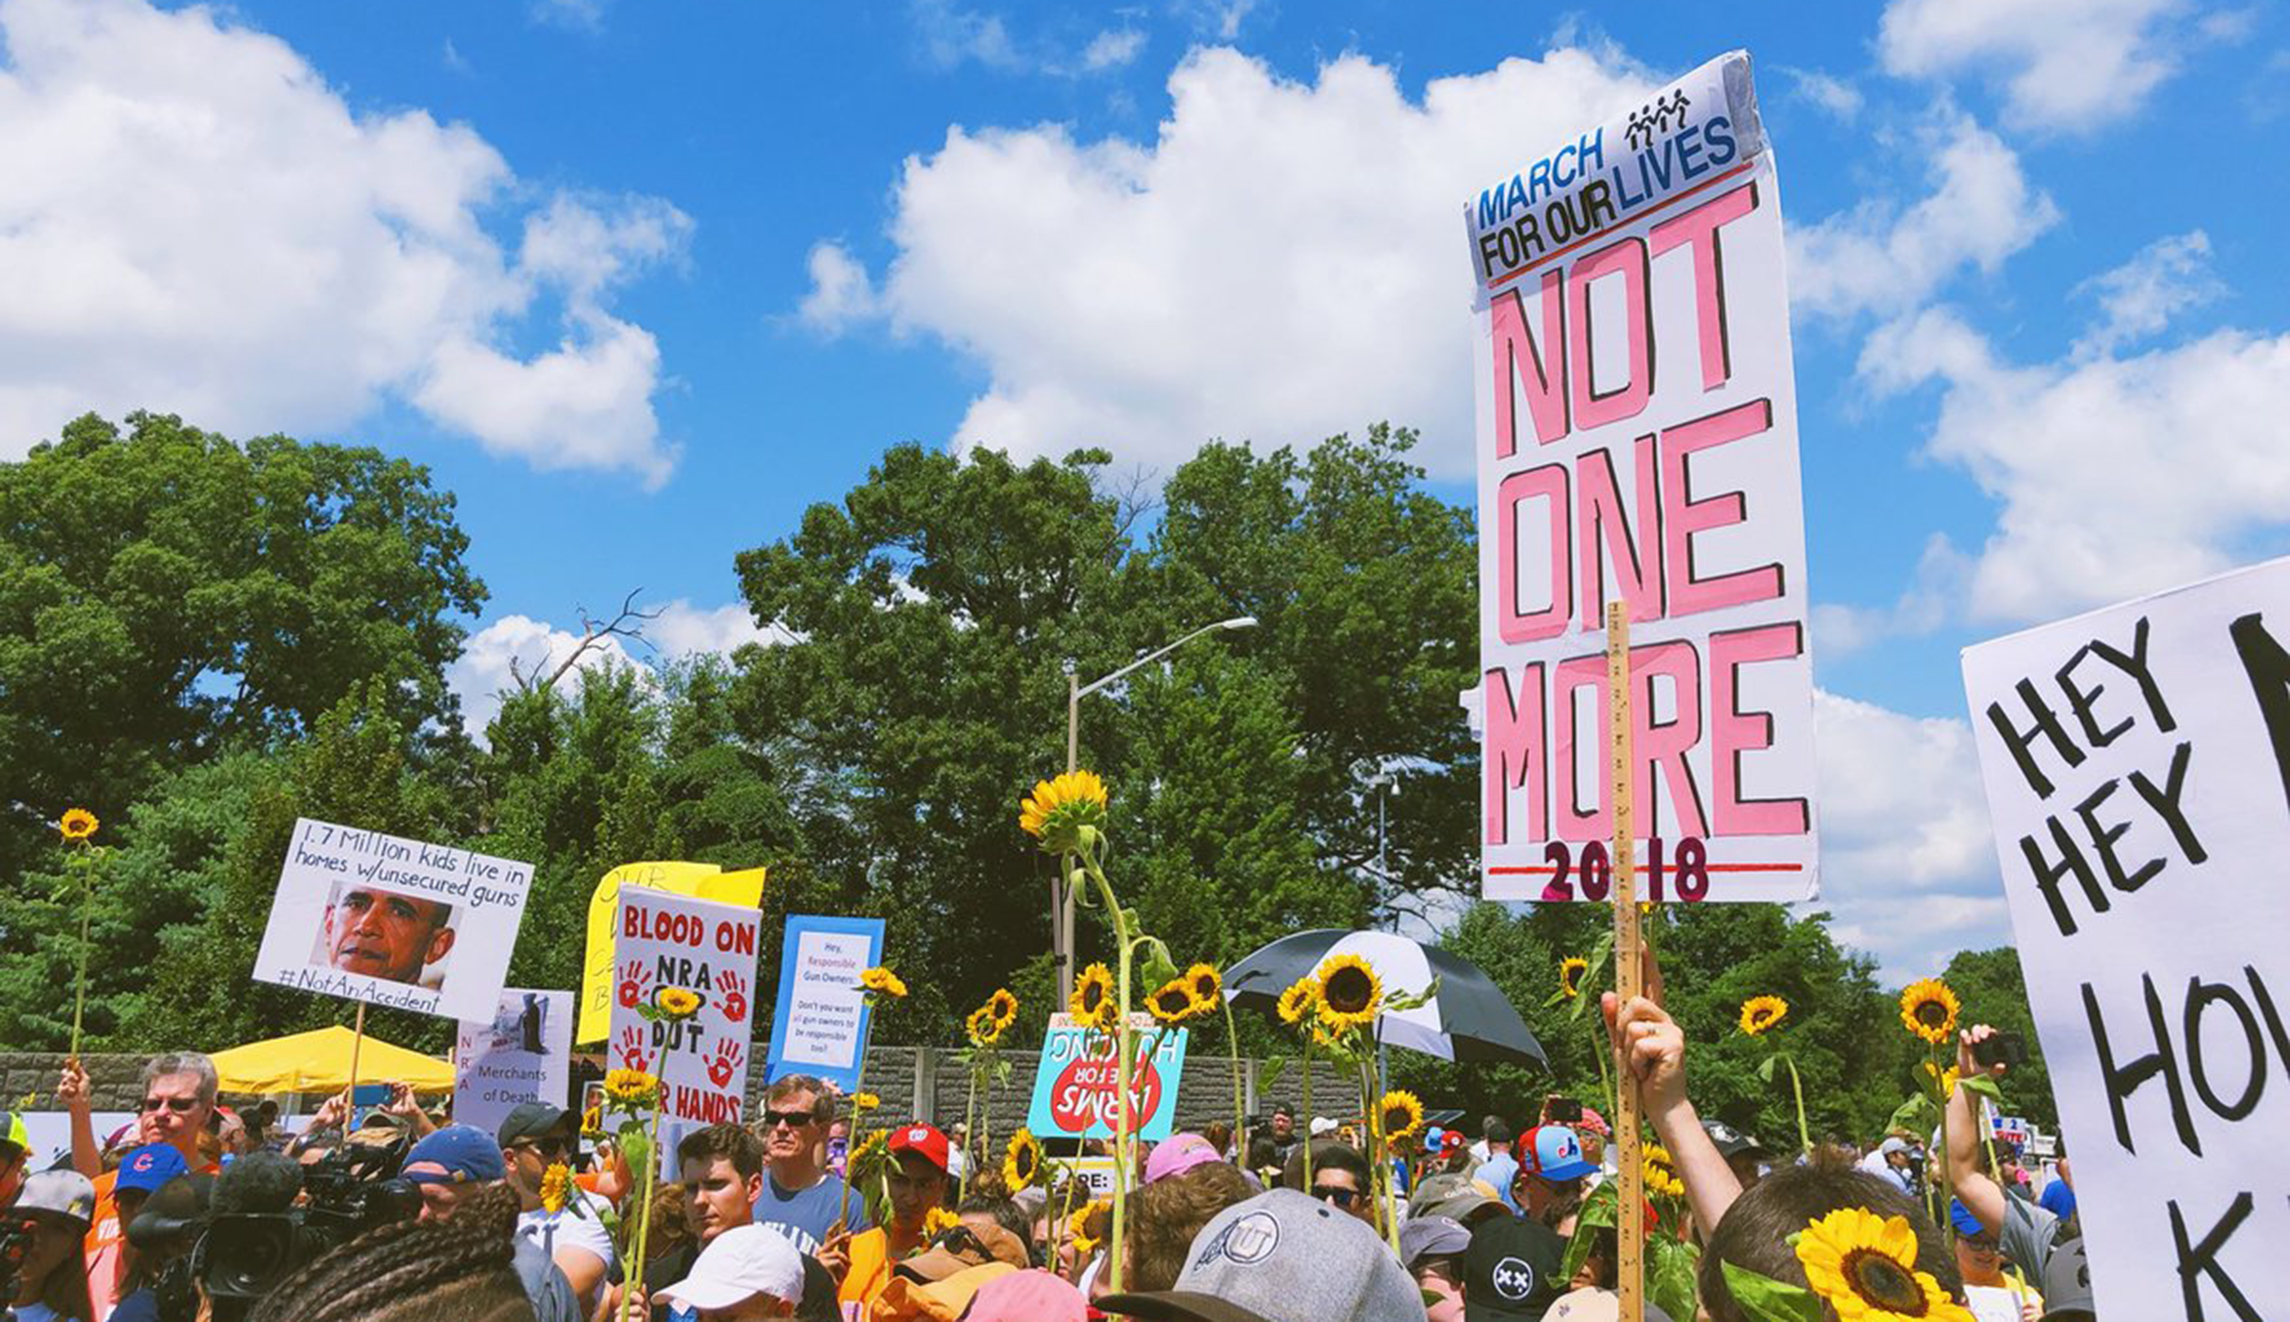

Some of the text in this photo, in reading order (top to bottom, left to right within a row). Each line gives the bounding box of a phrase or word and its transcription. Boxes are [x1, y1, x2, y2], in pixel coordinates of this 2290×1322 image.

[1477, 127, 1604, 229] MARCH
[1478, 116, 1736, 277] FOR OUR LIVES
[1490, 179, 1760, 460] NOT
[1498, 397, 1785, 645] ONE
[1986, 616, 2177, 799] HEY
[1485, 620, 1810, 845] MORE
[303, 824, 526, 887] 1.7 Million kids live in
[2020, 740, 2208, 936] HEY
[295, 842, 520, 908] homes w/unsecured guns
[624, 904, 704, 948] BLOOD
[715, 920, 756, 956] ON
[656, 954, 711, 991] NRA
[803, 972, 820, 982] Gun
[807, 956, 856, 970] Responsible
[278, 968, 443, 1014] #NotAnAccident
[797, 1000, 854, 1013] Don't you want
[795, 1027, 848, 1041] be responsible
[802, 1016, 817, 1026] gun
[818, 1018, 844, 1027] owners
[846, 1020, 854, 1028] to
[810, 1043, 828, 1053] too?
[1049, 1032, 1181, 1064] HUGING
[478, 1065, 547, 1081] Merchants
[1074, 1066, 1105, 1084] FOR
[483, 1089, 539, 1103] of Death
[676, 1085, 741, 1126] HANDS
[1057, 1083, 1152, 1120] ARMS
[133, 1153, 153, 1173] C
[1229, 1222, 1272, 1260] U
